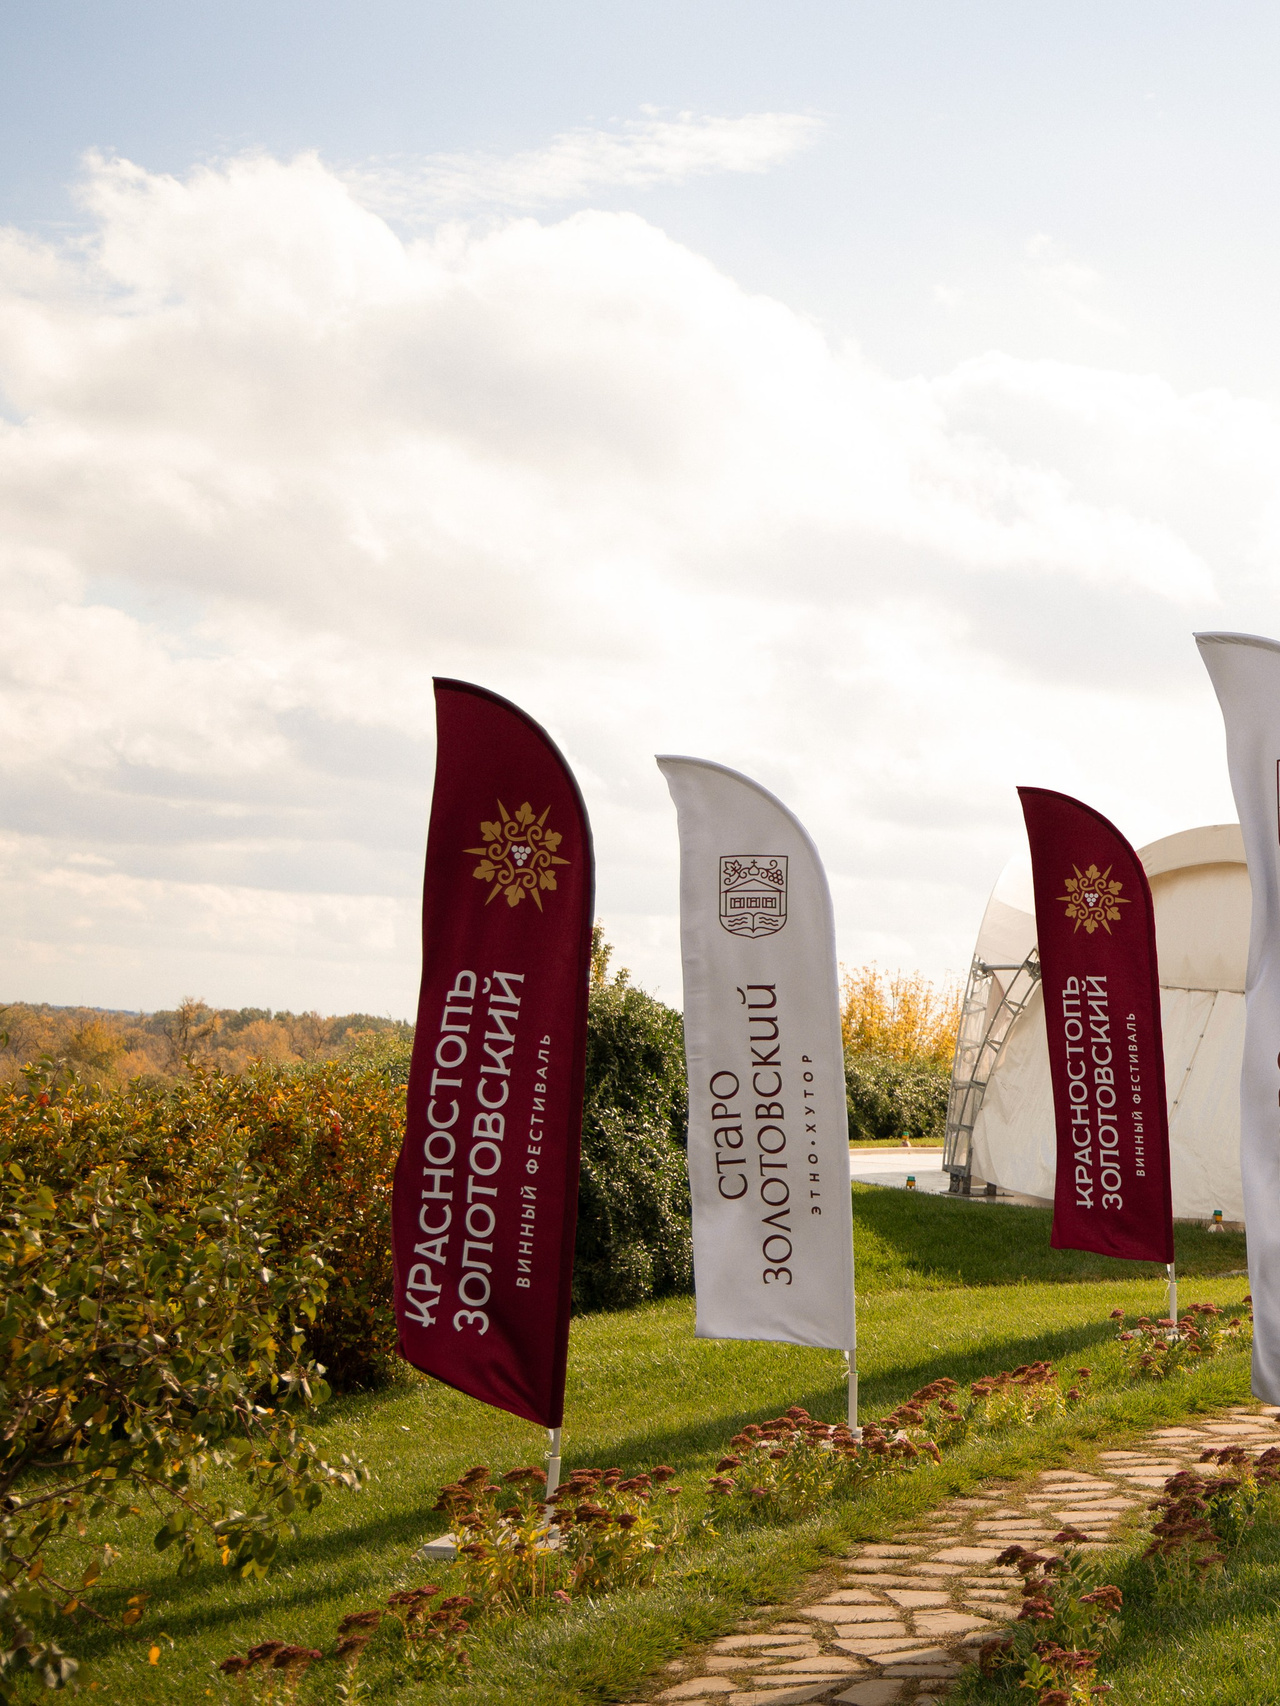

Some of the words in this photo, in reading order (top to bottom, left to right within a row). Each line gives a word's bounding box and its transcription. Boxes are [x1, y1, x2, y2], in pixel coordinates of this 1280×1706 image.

[405, 969, 477, 1328] КРАСНОСТОПЪ
[526, 1034, 551, 1175] ФЕСТИВАЛЬ
[1062, 975, 1094, 1209] КРАСНОСТОПЪ
[1081, 975, 1122, 1210] ЗОЛОТОВСКИЙ
[1127, 1013, 1142, 1104] ФЕСТИВАЛЬ
[1133, 1111, 1146, 1177] ВИННЫЙ
[453, 970, 525, 1335] ЗОЛОТОВСКИЙ
[516, 1185, 537, 1288] ВИННЫЙ
